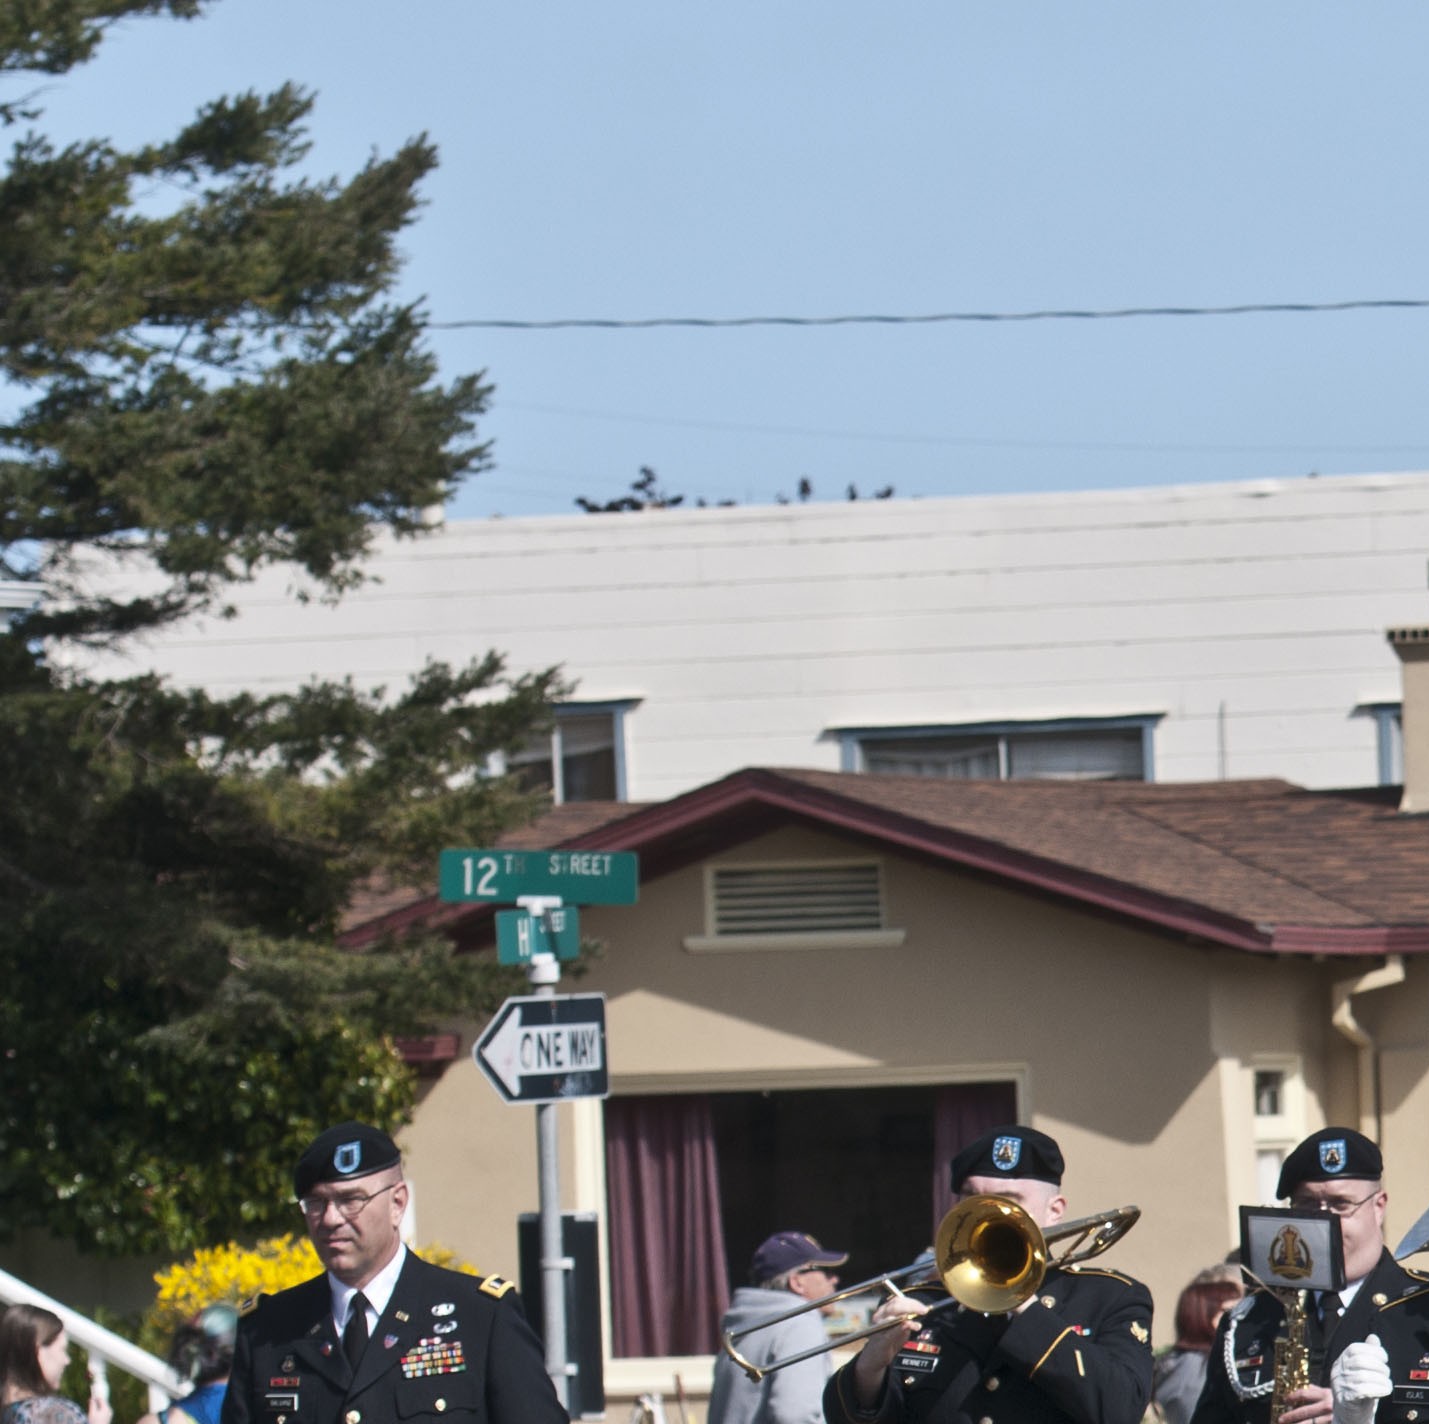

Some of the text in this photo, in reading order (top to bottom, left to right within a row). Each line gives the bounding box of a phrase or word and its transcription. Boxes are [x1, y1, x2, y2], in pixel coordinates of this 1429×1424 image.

[517, 918, 530, 957] H
[520, 1029, 596, 1070] ONE WAY
